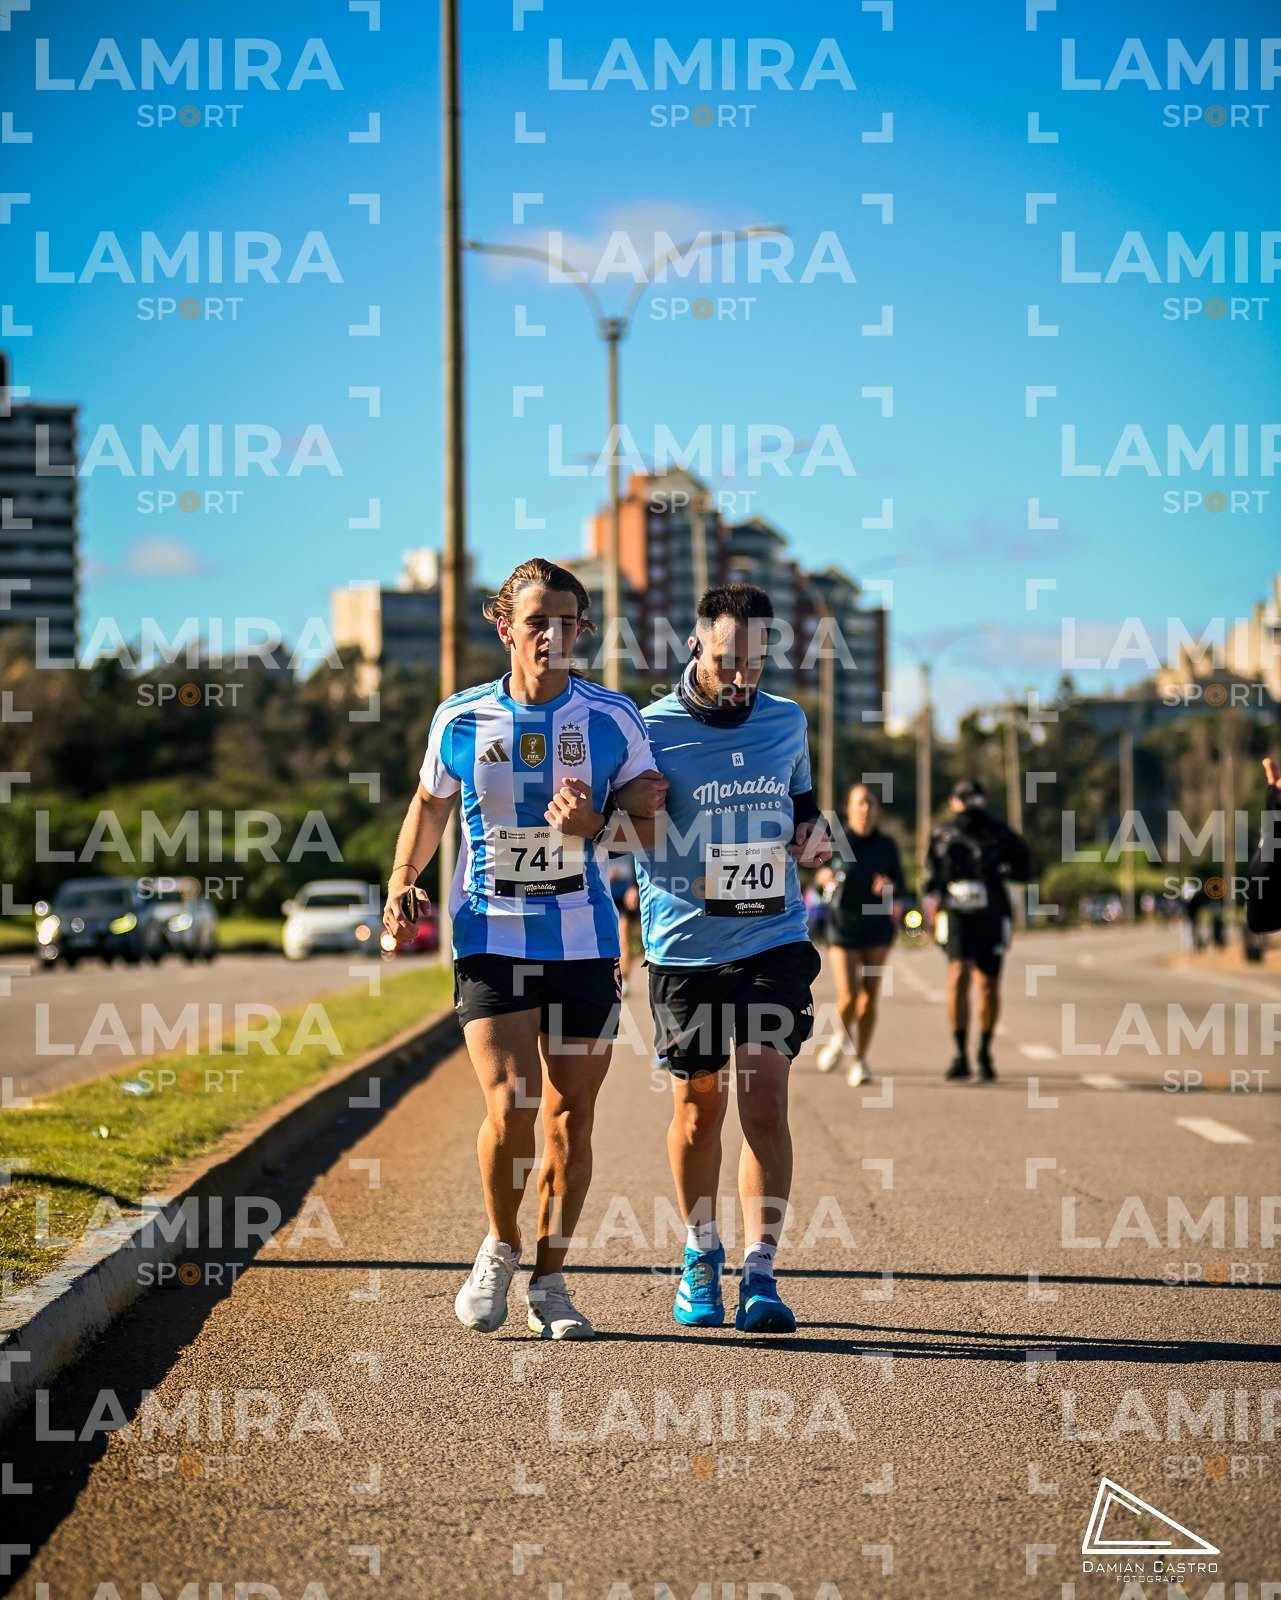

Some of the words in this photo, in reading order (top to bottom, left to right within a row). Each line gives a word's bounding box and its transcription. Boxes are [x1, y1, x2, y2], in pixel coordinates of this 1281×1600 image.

[692, 775, 787, 806] Maratón
[705, 800, 781, 817] MONTEVIDEO
[510, 845, 564, 872] 741
[722, 863, 774, 890] 740
